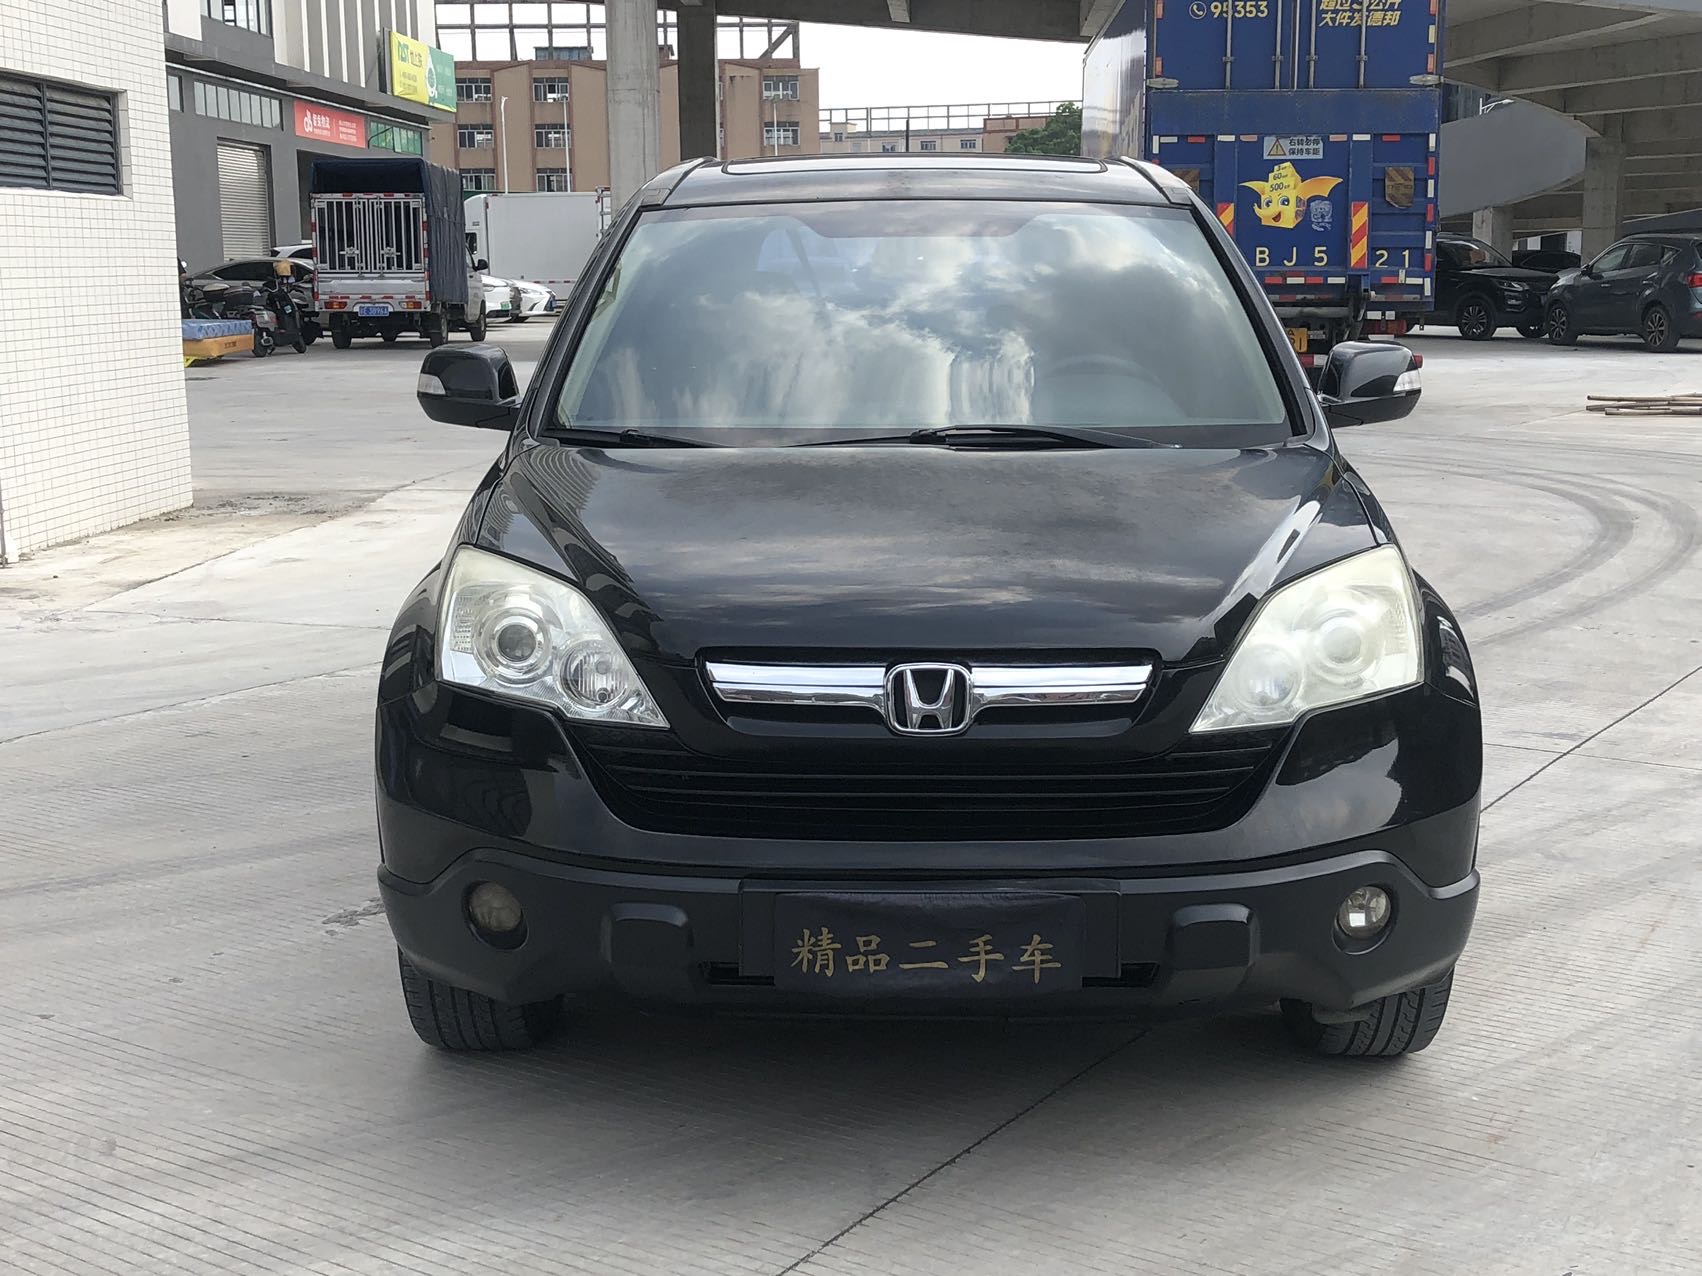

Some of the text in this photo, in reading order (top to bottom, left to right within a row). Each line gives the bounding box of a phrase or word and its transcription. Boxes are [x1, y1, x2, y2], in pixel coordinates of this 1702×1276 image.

[1210, 1, 1269, 18] 95353
[1318, 11, 1401, 26] 大件发德邦
[1288, 136, 1320, 146] 右转必停
[1288, 147, 1320, 156] 保持车距
[791, 927, 1062, 985] 精品二手车
